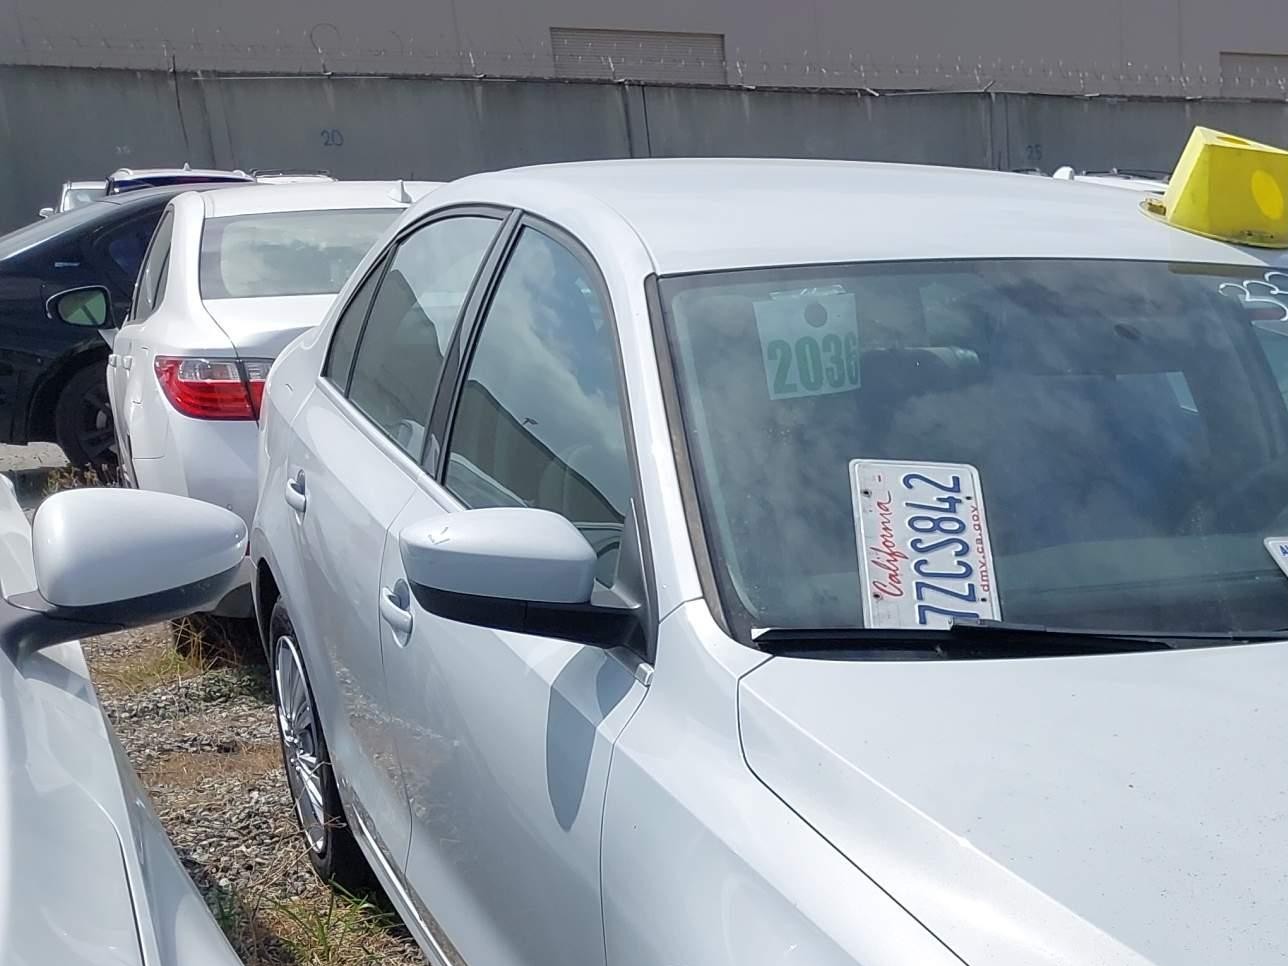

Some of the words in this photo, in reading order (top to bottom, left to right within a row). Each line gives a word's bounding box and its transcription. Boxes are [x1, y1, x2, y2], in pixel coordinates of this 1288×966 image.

[320, 129, 345, 146] 20
[869, 490, 909, 598] California
[902, 473, 979, 625] 7ZCS842
